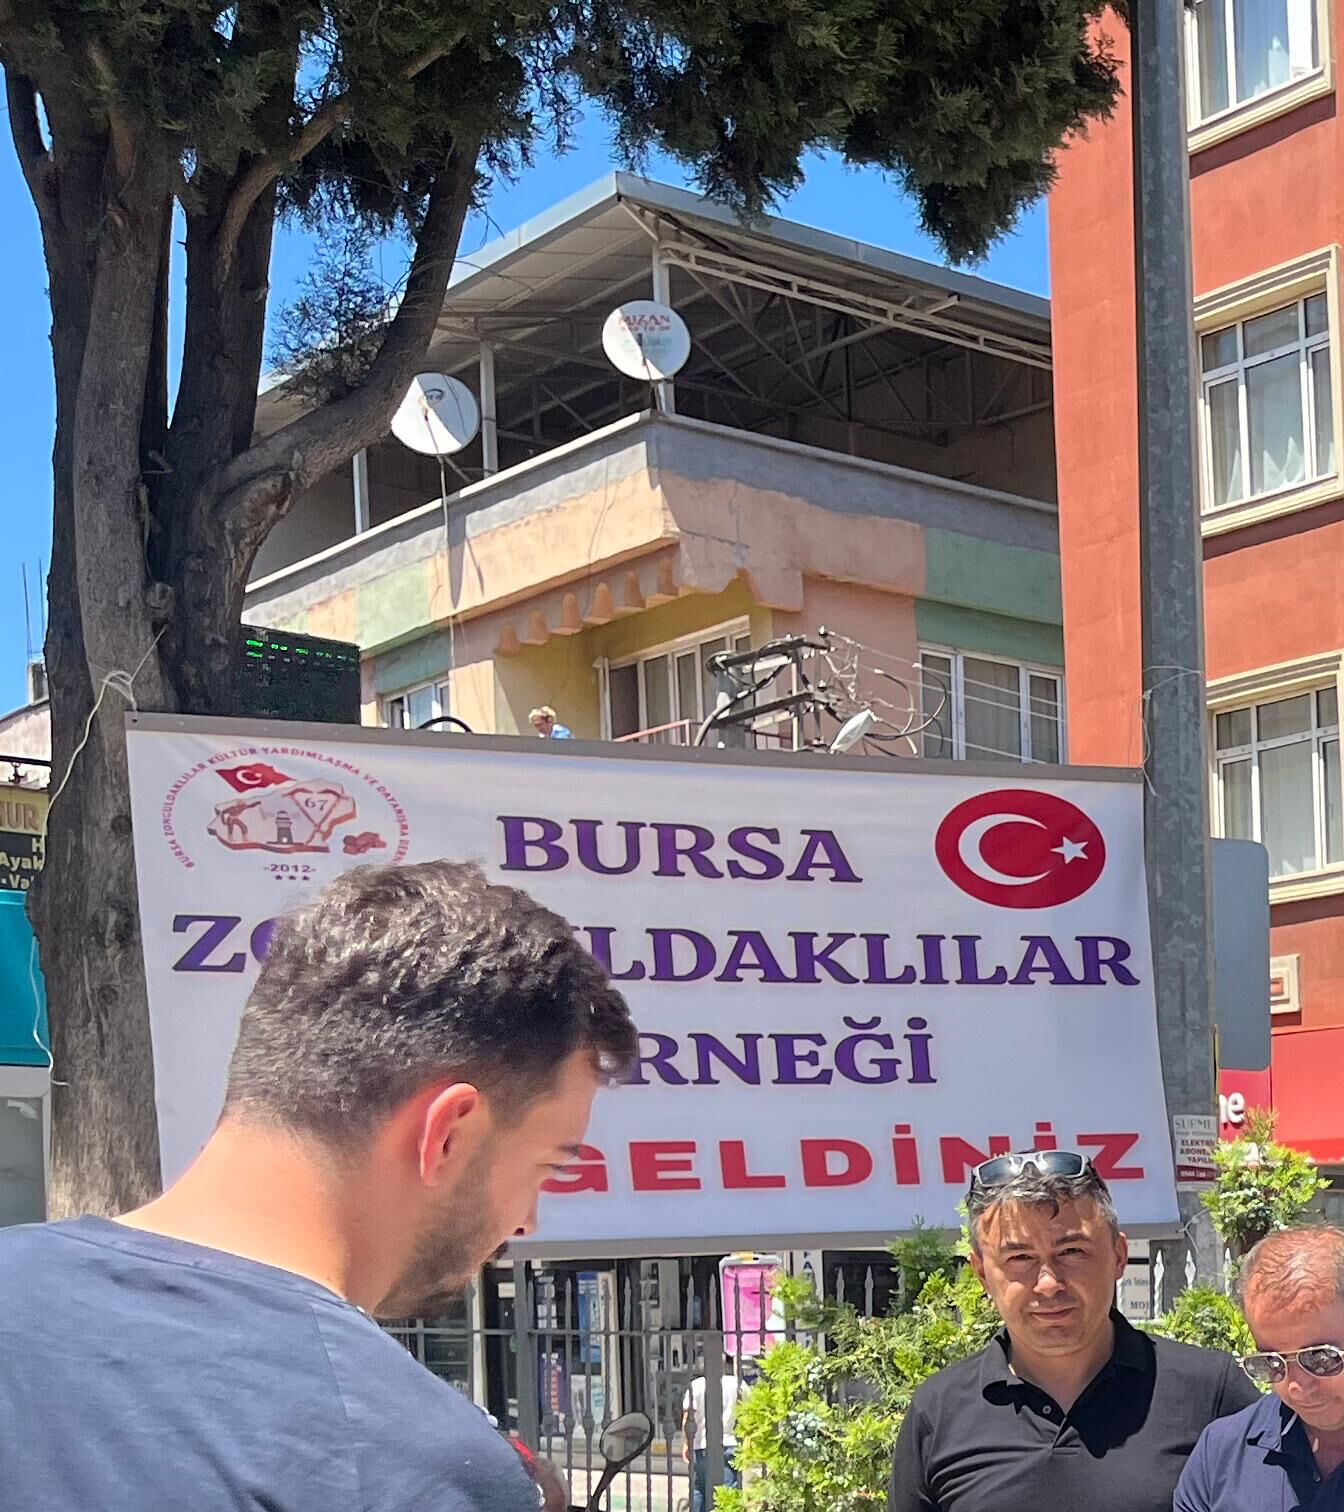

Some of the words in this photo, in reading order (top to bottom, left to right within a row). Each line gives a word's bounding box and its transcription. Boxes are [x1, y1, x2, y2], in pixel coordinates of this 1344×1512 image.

[167, 838, 195, 869] BURSA
[496, 815, 864, 884] BURSA
[172, 914, 1141, 986] ZLDAKLILAR
[612, 1015, 938, 1086] RNEĞİ
